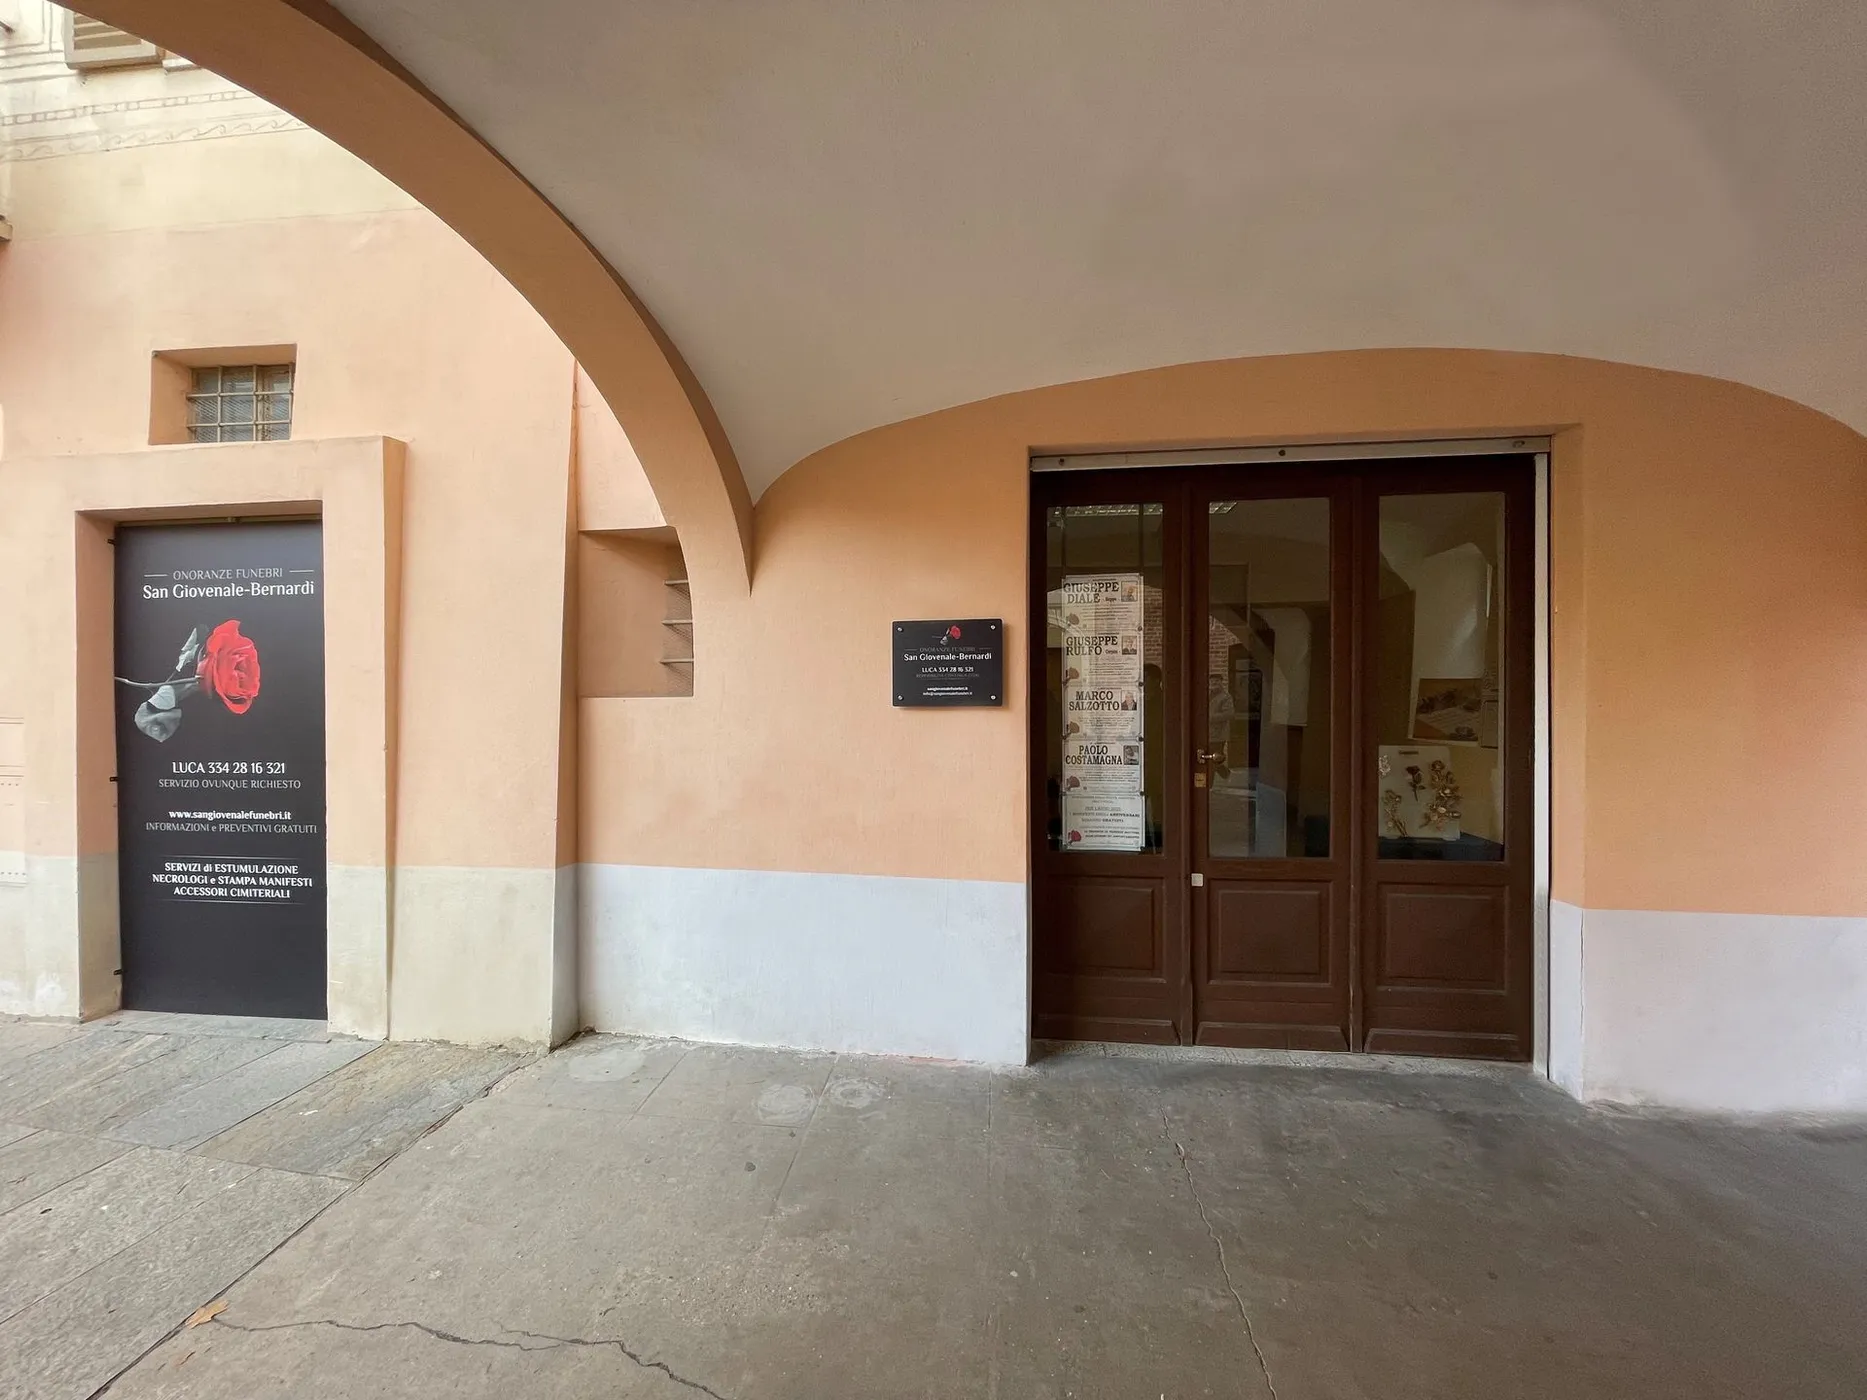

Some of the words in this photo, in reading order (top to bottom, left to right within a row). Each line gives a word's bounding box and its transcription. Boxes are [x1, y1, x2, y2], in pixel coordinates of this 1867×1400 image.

[172, 569, 233, 580] ONORANZE
[236, 568, 283, 579] FUNEBRI
[143, 584, 168, 599] San
[172, 580, 314, 598] Giovenale-Bernardi
[1063, 582, 1119, 593] GIUSEPPE
[1067, 593, 1100, 604] DIALE
[1066, 635, 1118, 646] GIUSEPPE
[1066, 646, 1102, 656] RULFO
[904, 653, 918, 661] San
[1075, 691, 1113, 701] MARCO
[1069, 701, 1120, 711] SALZOTTO
[1079, 745, 1108, 755] PAOLO
[1065, 755, 1122, 765] COSTAMAGNA
[172, 761, 206, 774] LUCA
[207, 761, 230, 774] 334
[232, 761, 248, 774] 28
[250, 762, 263, 774] 16
[266, 762, 285, 774] 321
[158, 778, 200, 788] SERVIZIO
[202, 779, 249, 790] OVUNQUE
[251, 779, 301, 789] RICHIESTO
[168, 810, 292, 821] www.sangiovenalefunebri.it
[146, 822, 209, 832] INFORMAZIONI
[219, 823, 272, 833] PREVENTIVI
[273, 824, 317, 834] GRATUITI
[164, 862, 201, 872] SERVIZI
[203, 863, 213, 872] di
[214, 864, 298, 875] ESTUMULAZIONE
[152, 874, 208, 885] NECROLOGI
[210, 877, 216, 885] e
[217, 876, 257, 886] STAMPA
[258, 877, 313, 887] MANIFESTI
[173, 886, 228, 897] ACCESSORI
[229, 887, 290, 898] CIMITERIALI
